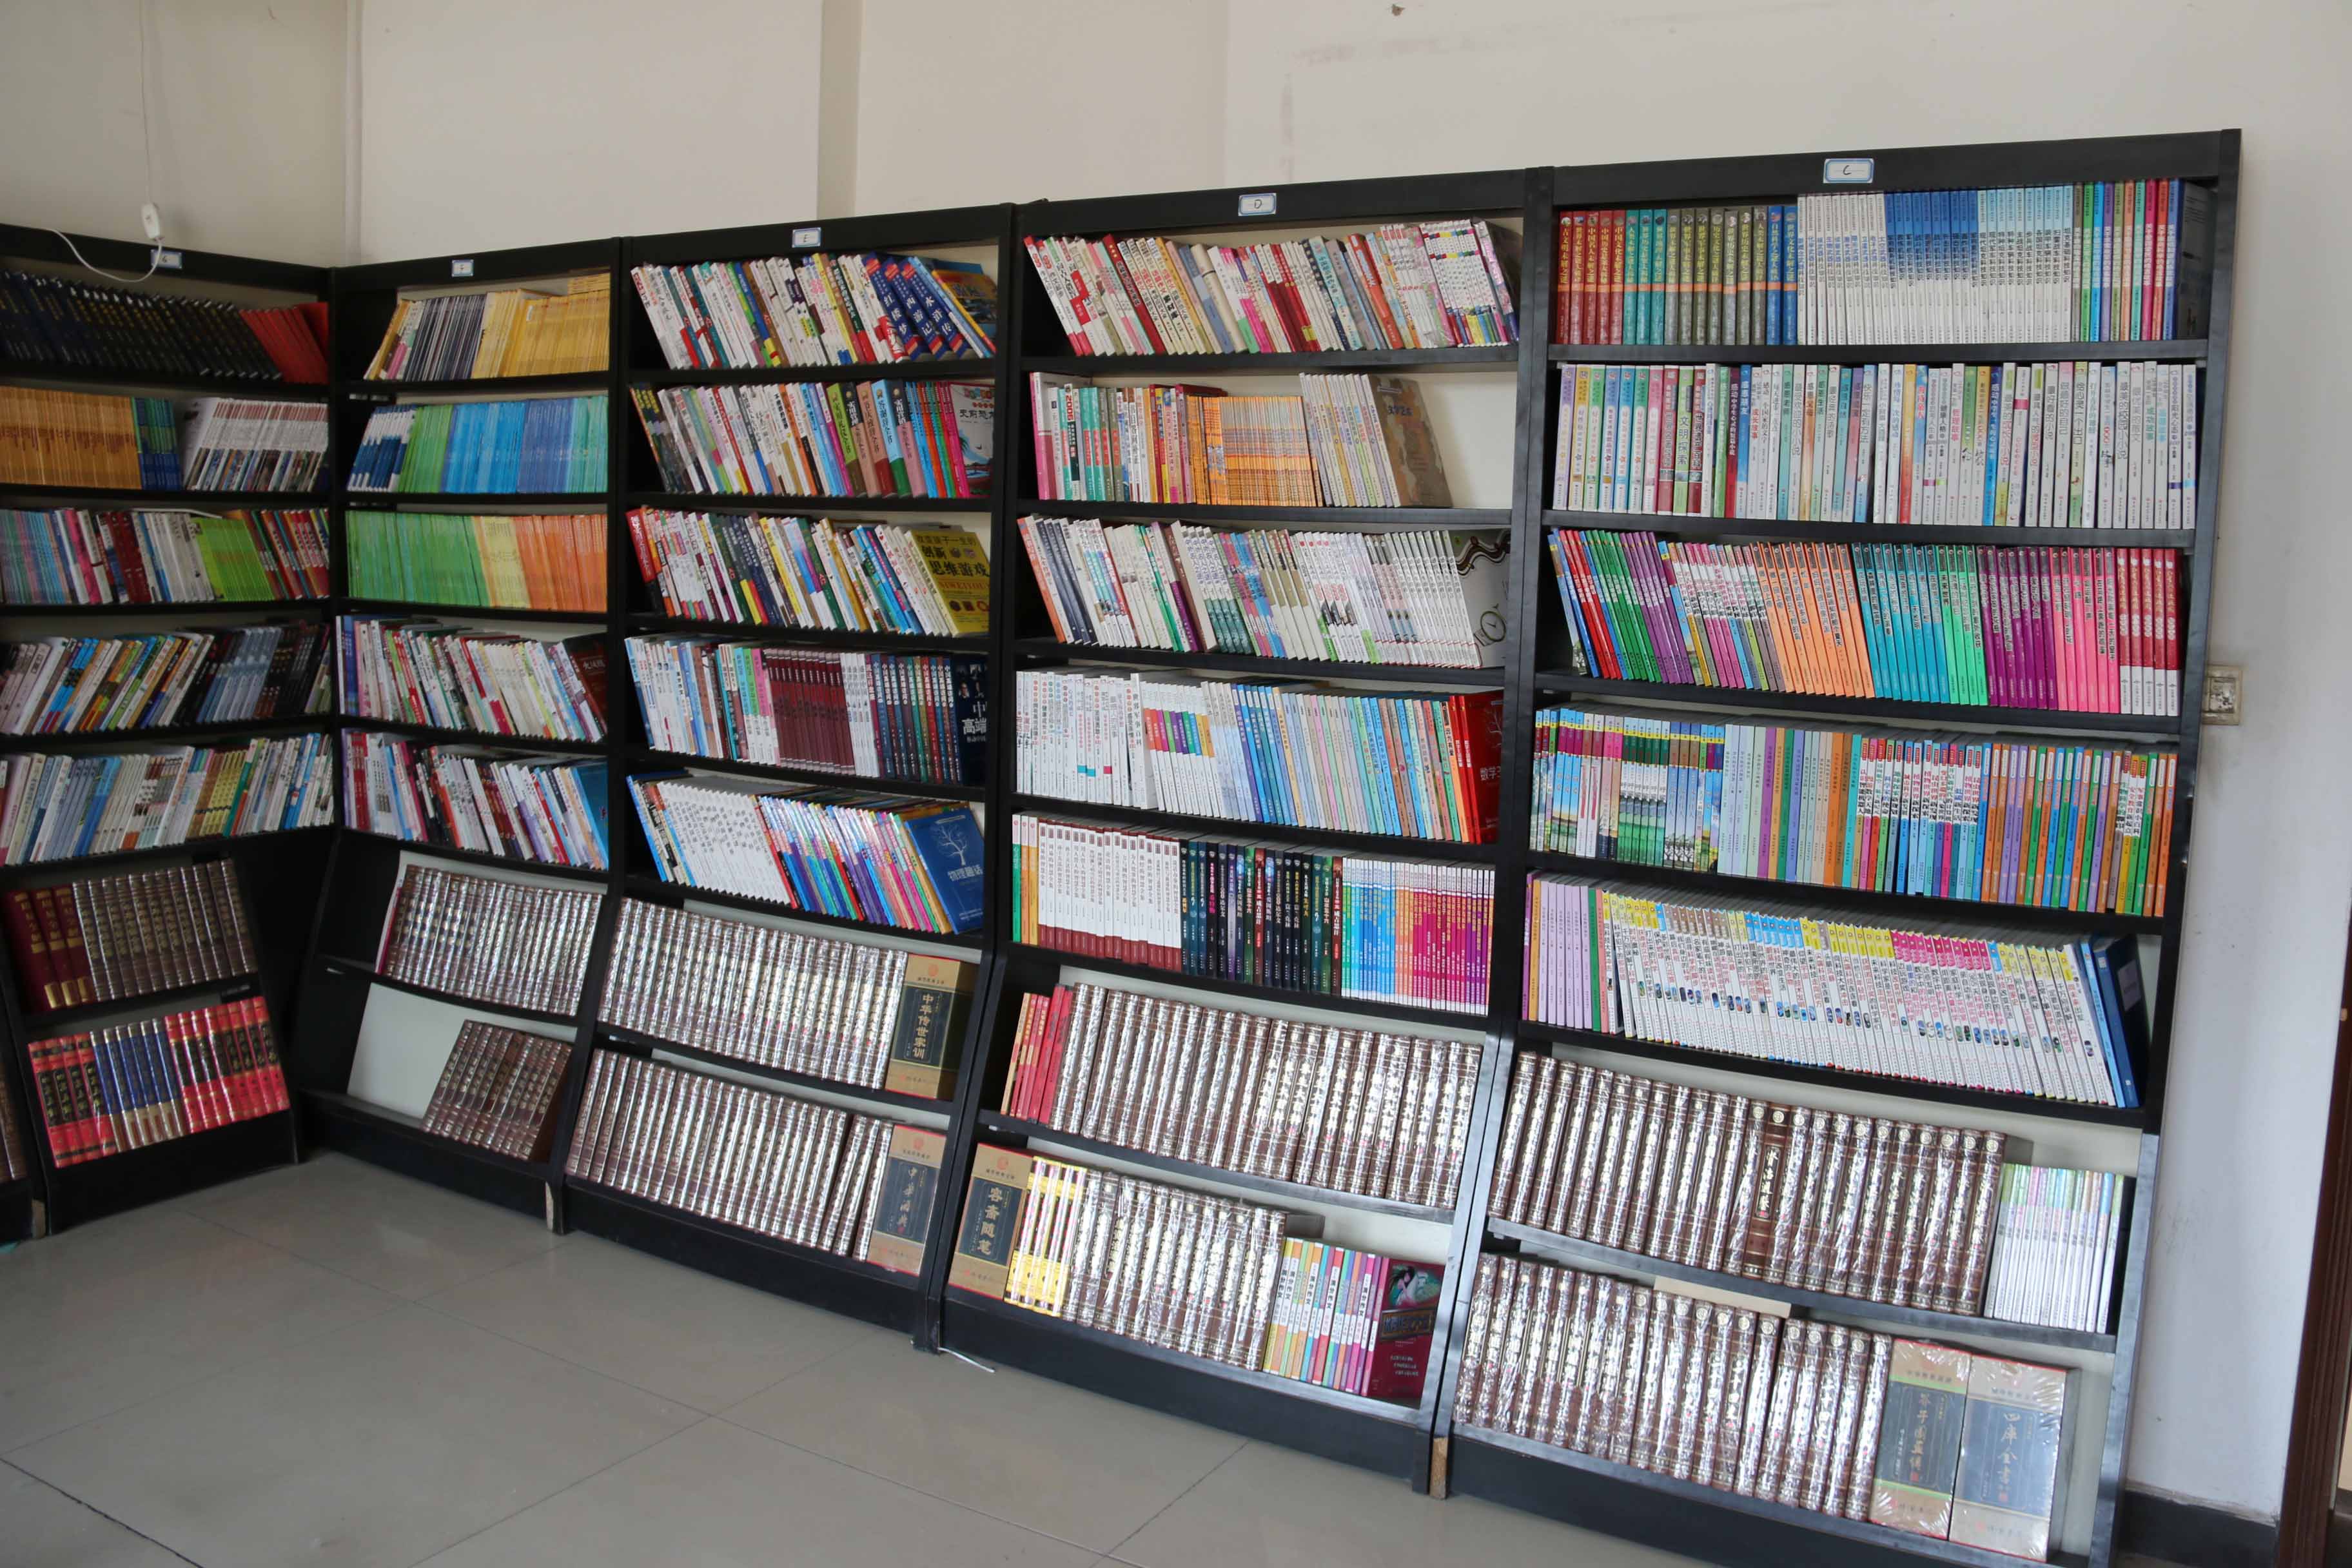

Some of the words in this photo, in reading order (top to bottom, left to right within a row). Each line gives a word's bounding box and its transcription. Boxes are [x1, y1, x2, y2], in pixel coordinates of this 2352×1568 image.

[1253, 199, 1263, 210] D
[883, 294, 908, 335] 红楼梦
[906, 295, 933, 335] 西游记
[925, 295, 953, 336] 水浒传
[1676, 416, 1690, 465] 文明探索
[930, 561, 991, 577] 思维游戏
[961, 718, 986, 734] 高端
[912, 994, 934, 1059] 中华传世家训
[977, 1187, 1003, 1255] 容斋随笔
